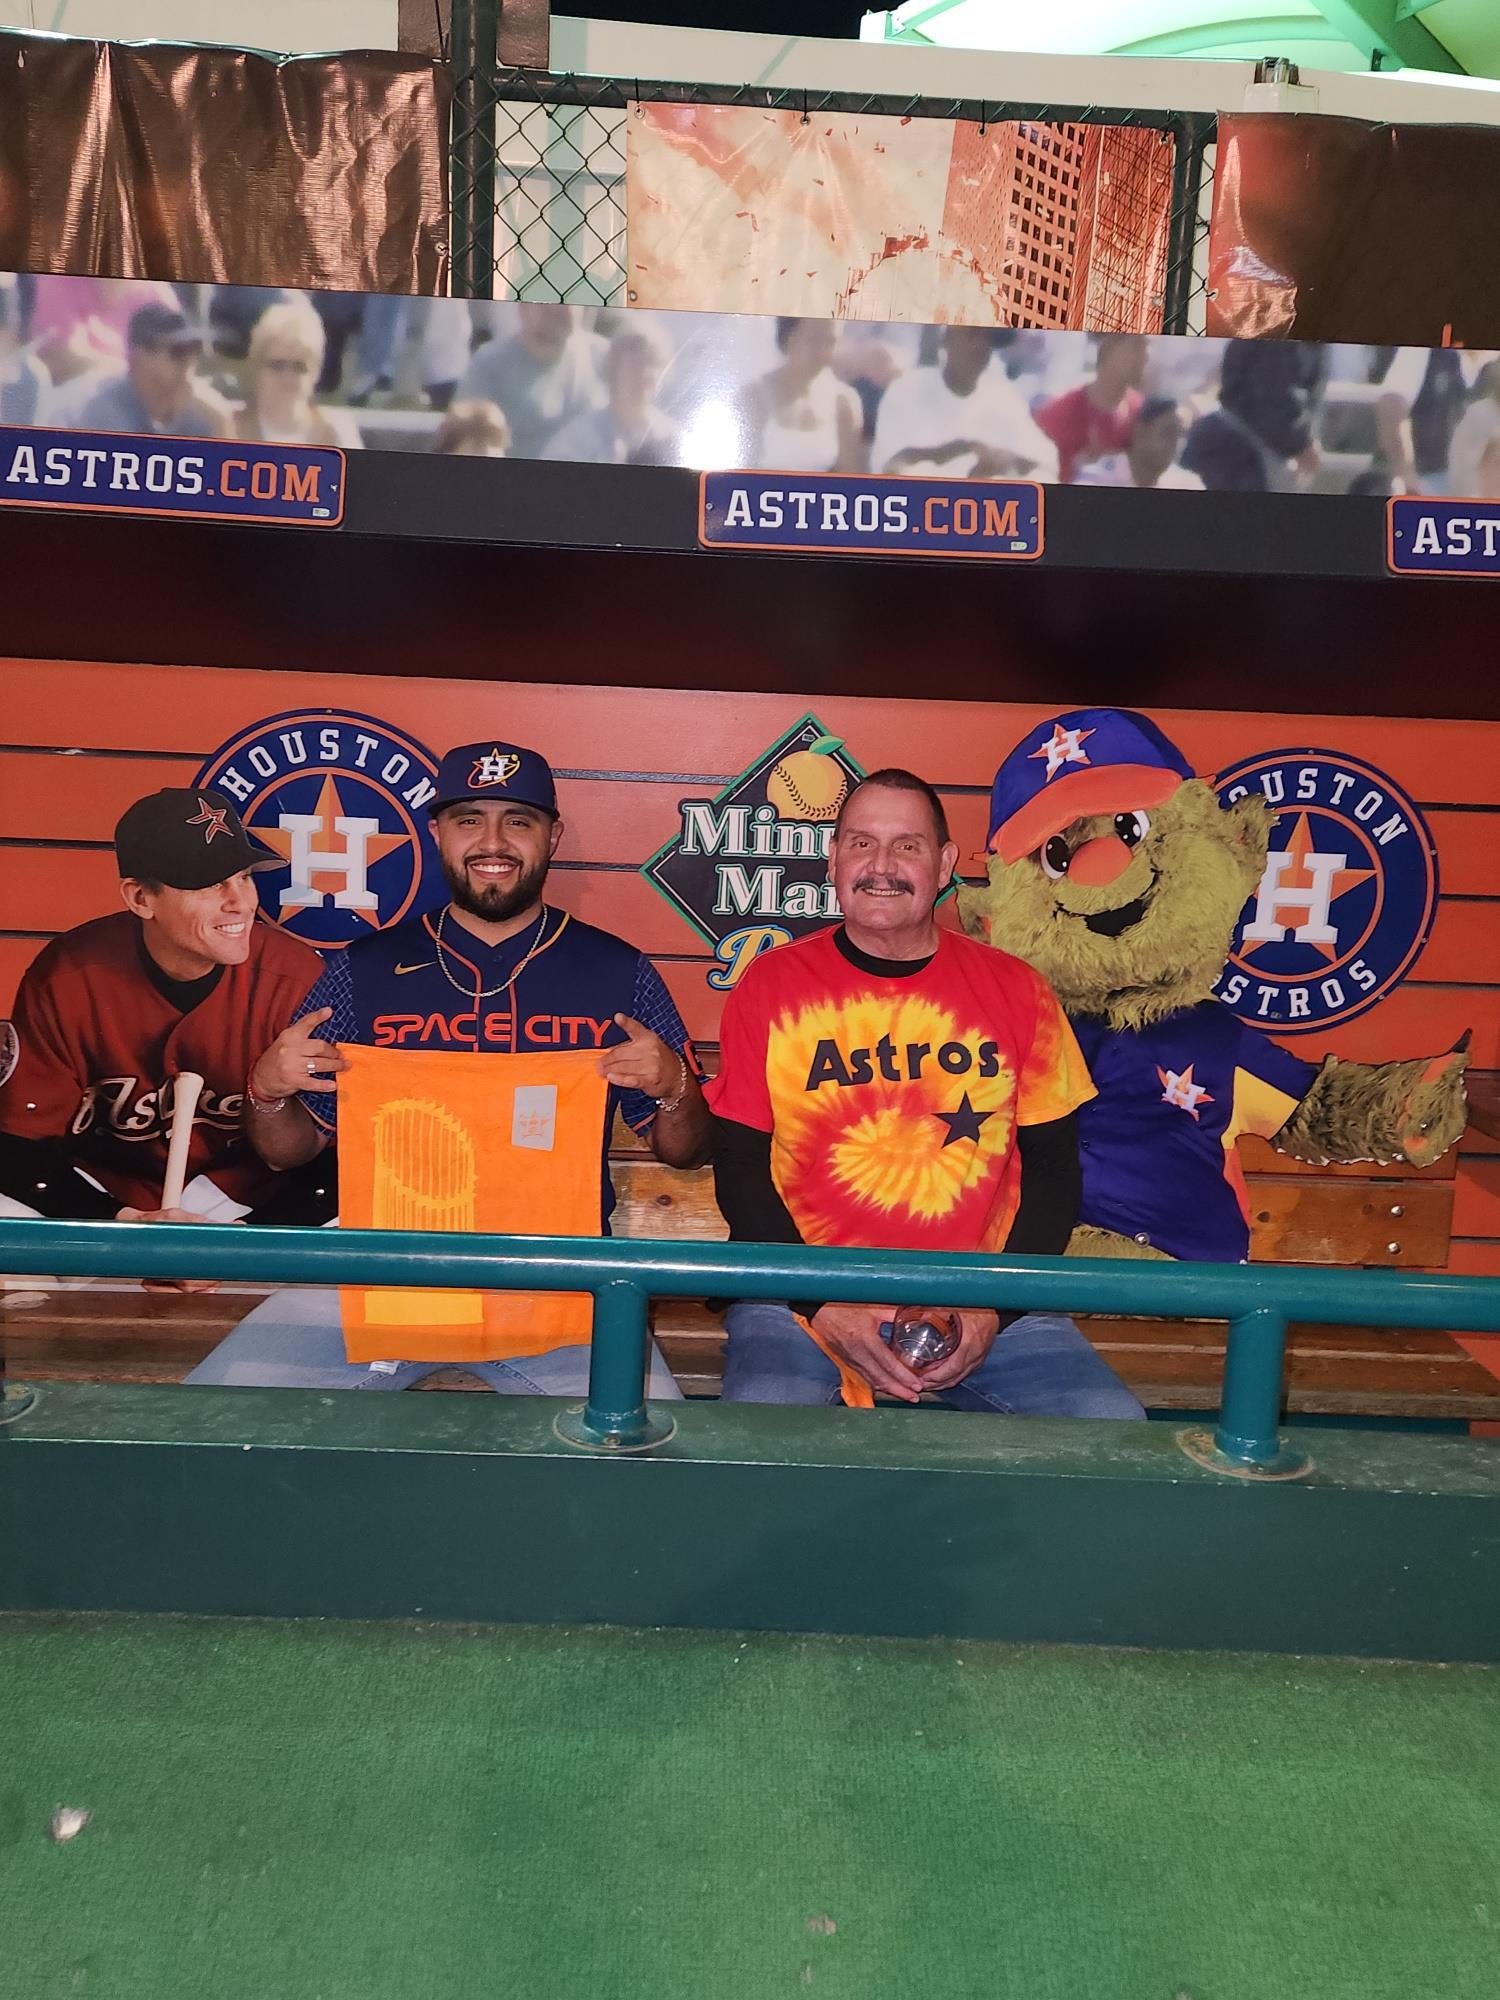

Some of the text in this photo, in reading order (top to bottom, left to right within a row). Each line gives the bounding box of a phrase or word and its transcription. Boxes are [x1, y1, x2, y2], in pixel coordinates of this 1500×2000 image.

[6, 445, 322, 503] ASTROS.COM
[723, 489, 1019, 537] ASTROS.COM
[218, 728, 437, 810] HOUSTON
[683, 803, 836, 857] Min
[1228, 767, 1409, 846] USTON
[715, 865, 844, 916] Mai
[1220, 959, 1377, 1018] STROS
[372, 1012, 612, 1046] SPACE CITY
[805, 1032, 999, 1091] Astros
